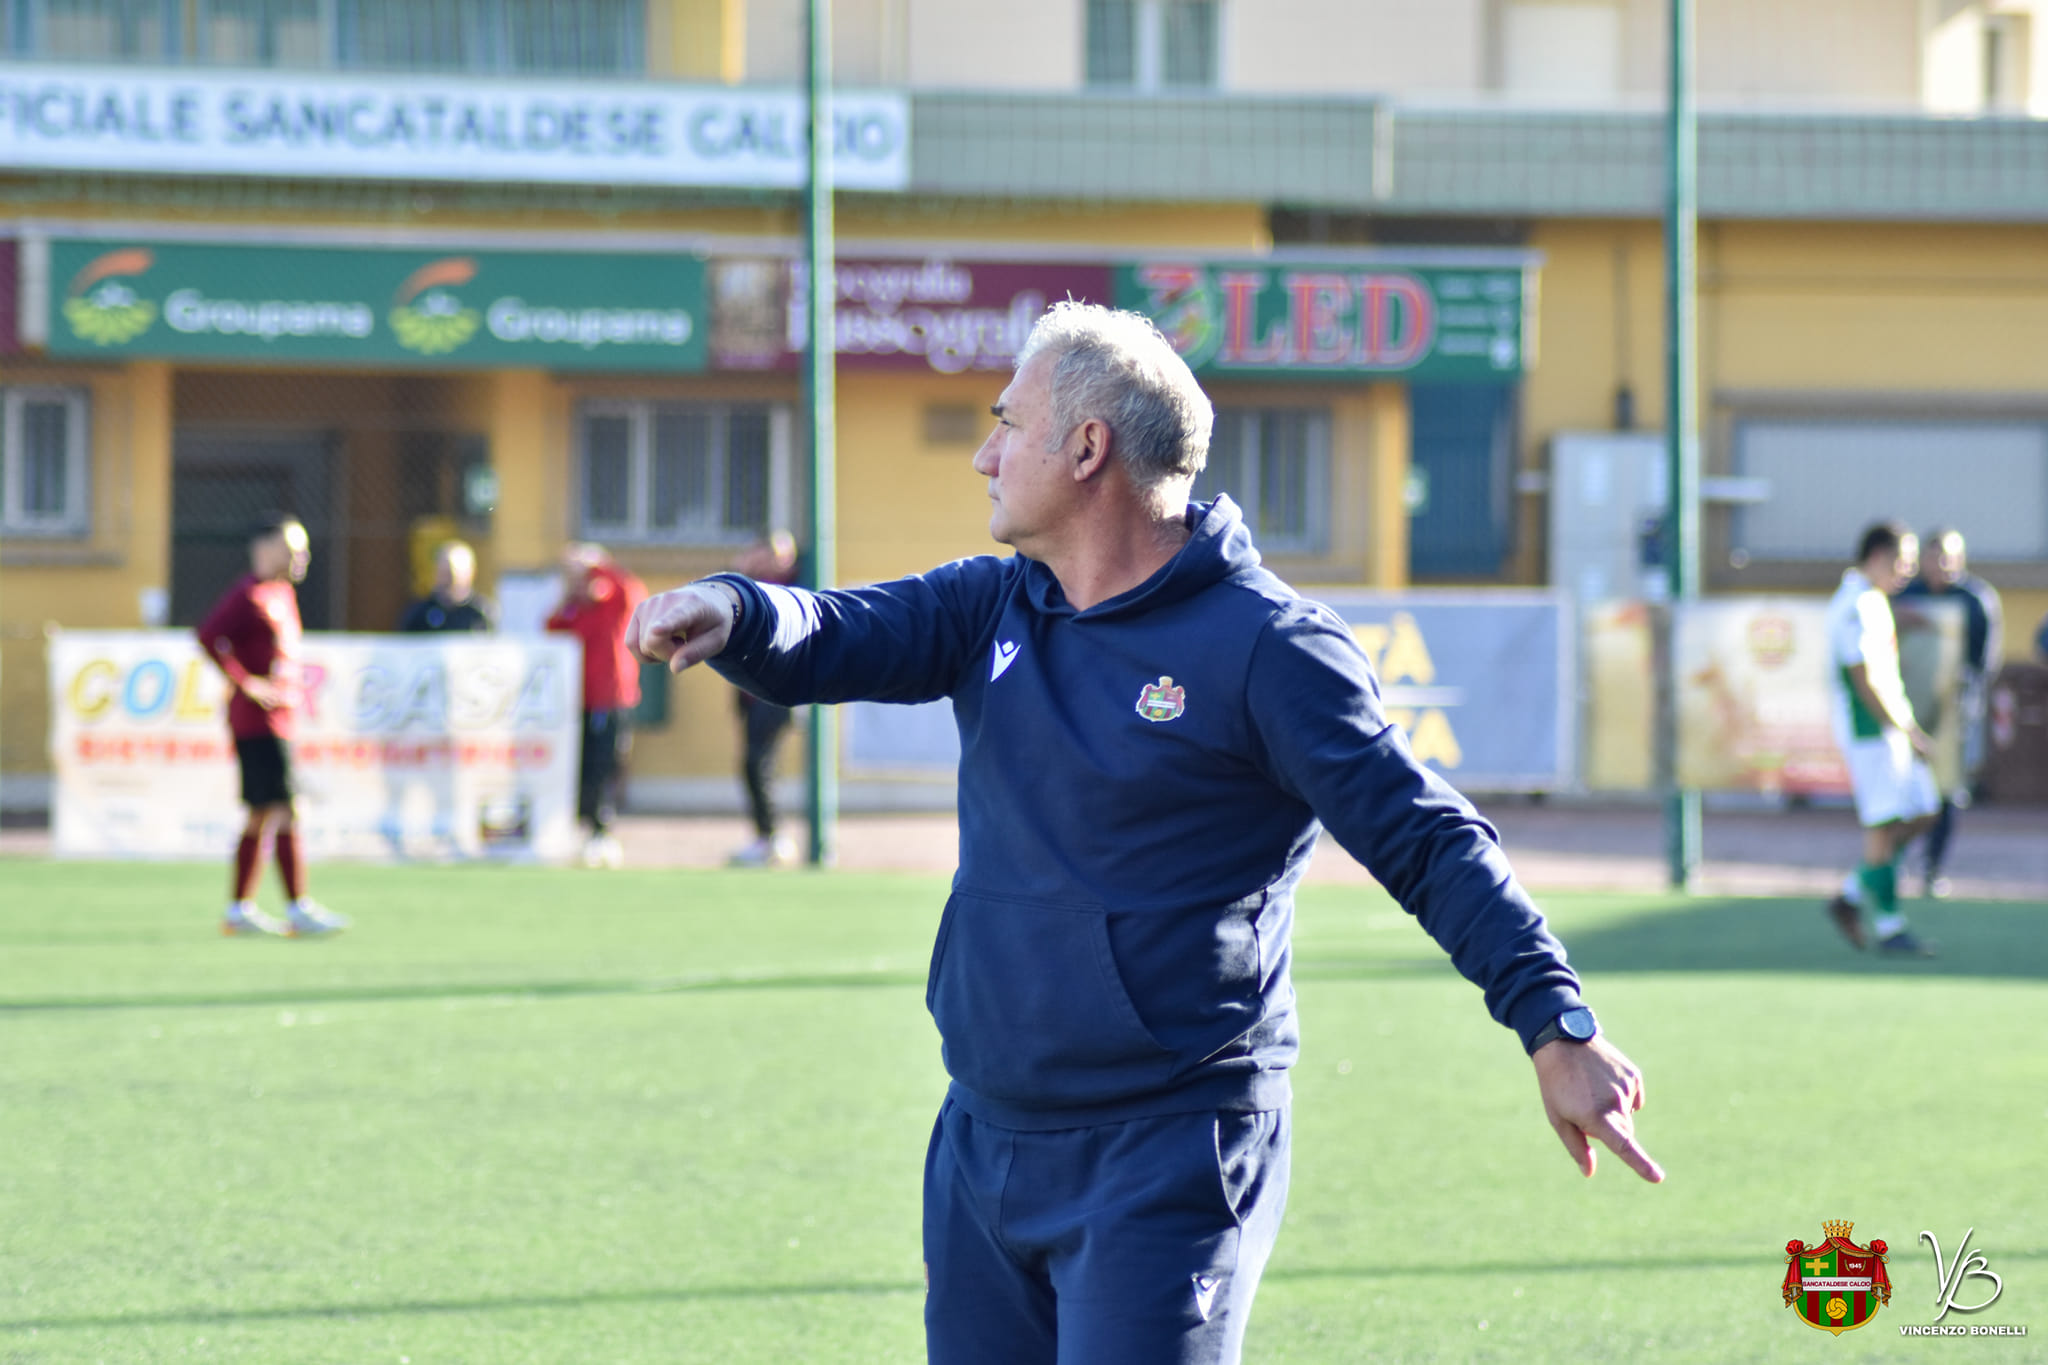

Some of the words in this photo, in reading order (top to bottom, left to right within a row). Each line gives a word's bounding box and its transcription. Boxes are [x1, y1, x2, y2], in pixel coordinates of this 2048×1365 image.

[0, 85, 200, 143] ICIALE
[221, 88, 668, 157] SANCATALDESE
[687, 105, 900, 162] CALIO
[164, 288, 374, 342] Groupama
[487, 296, 692, 350] Groupama
[68, 659, 326, 720] COLR
[348, 662, 557, 733] CASA
